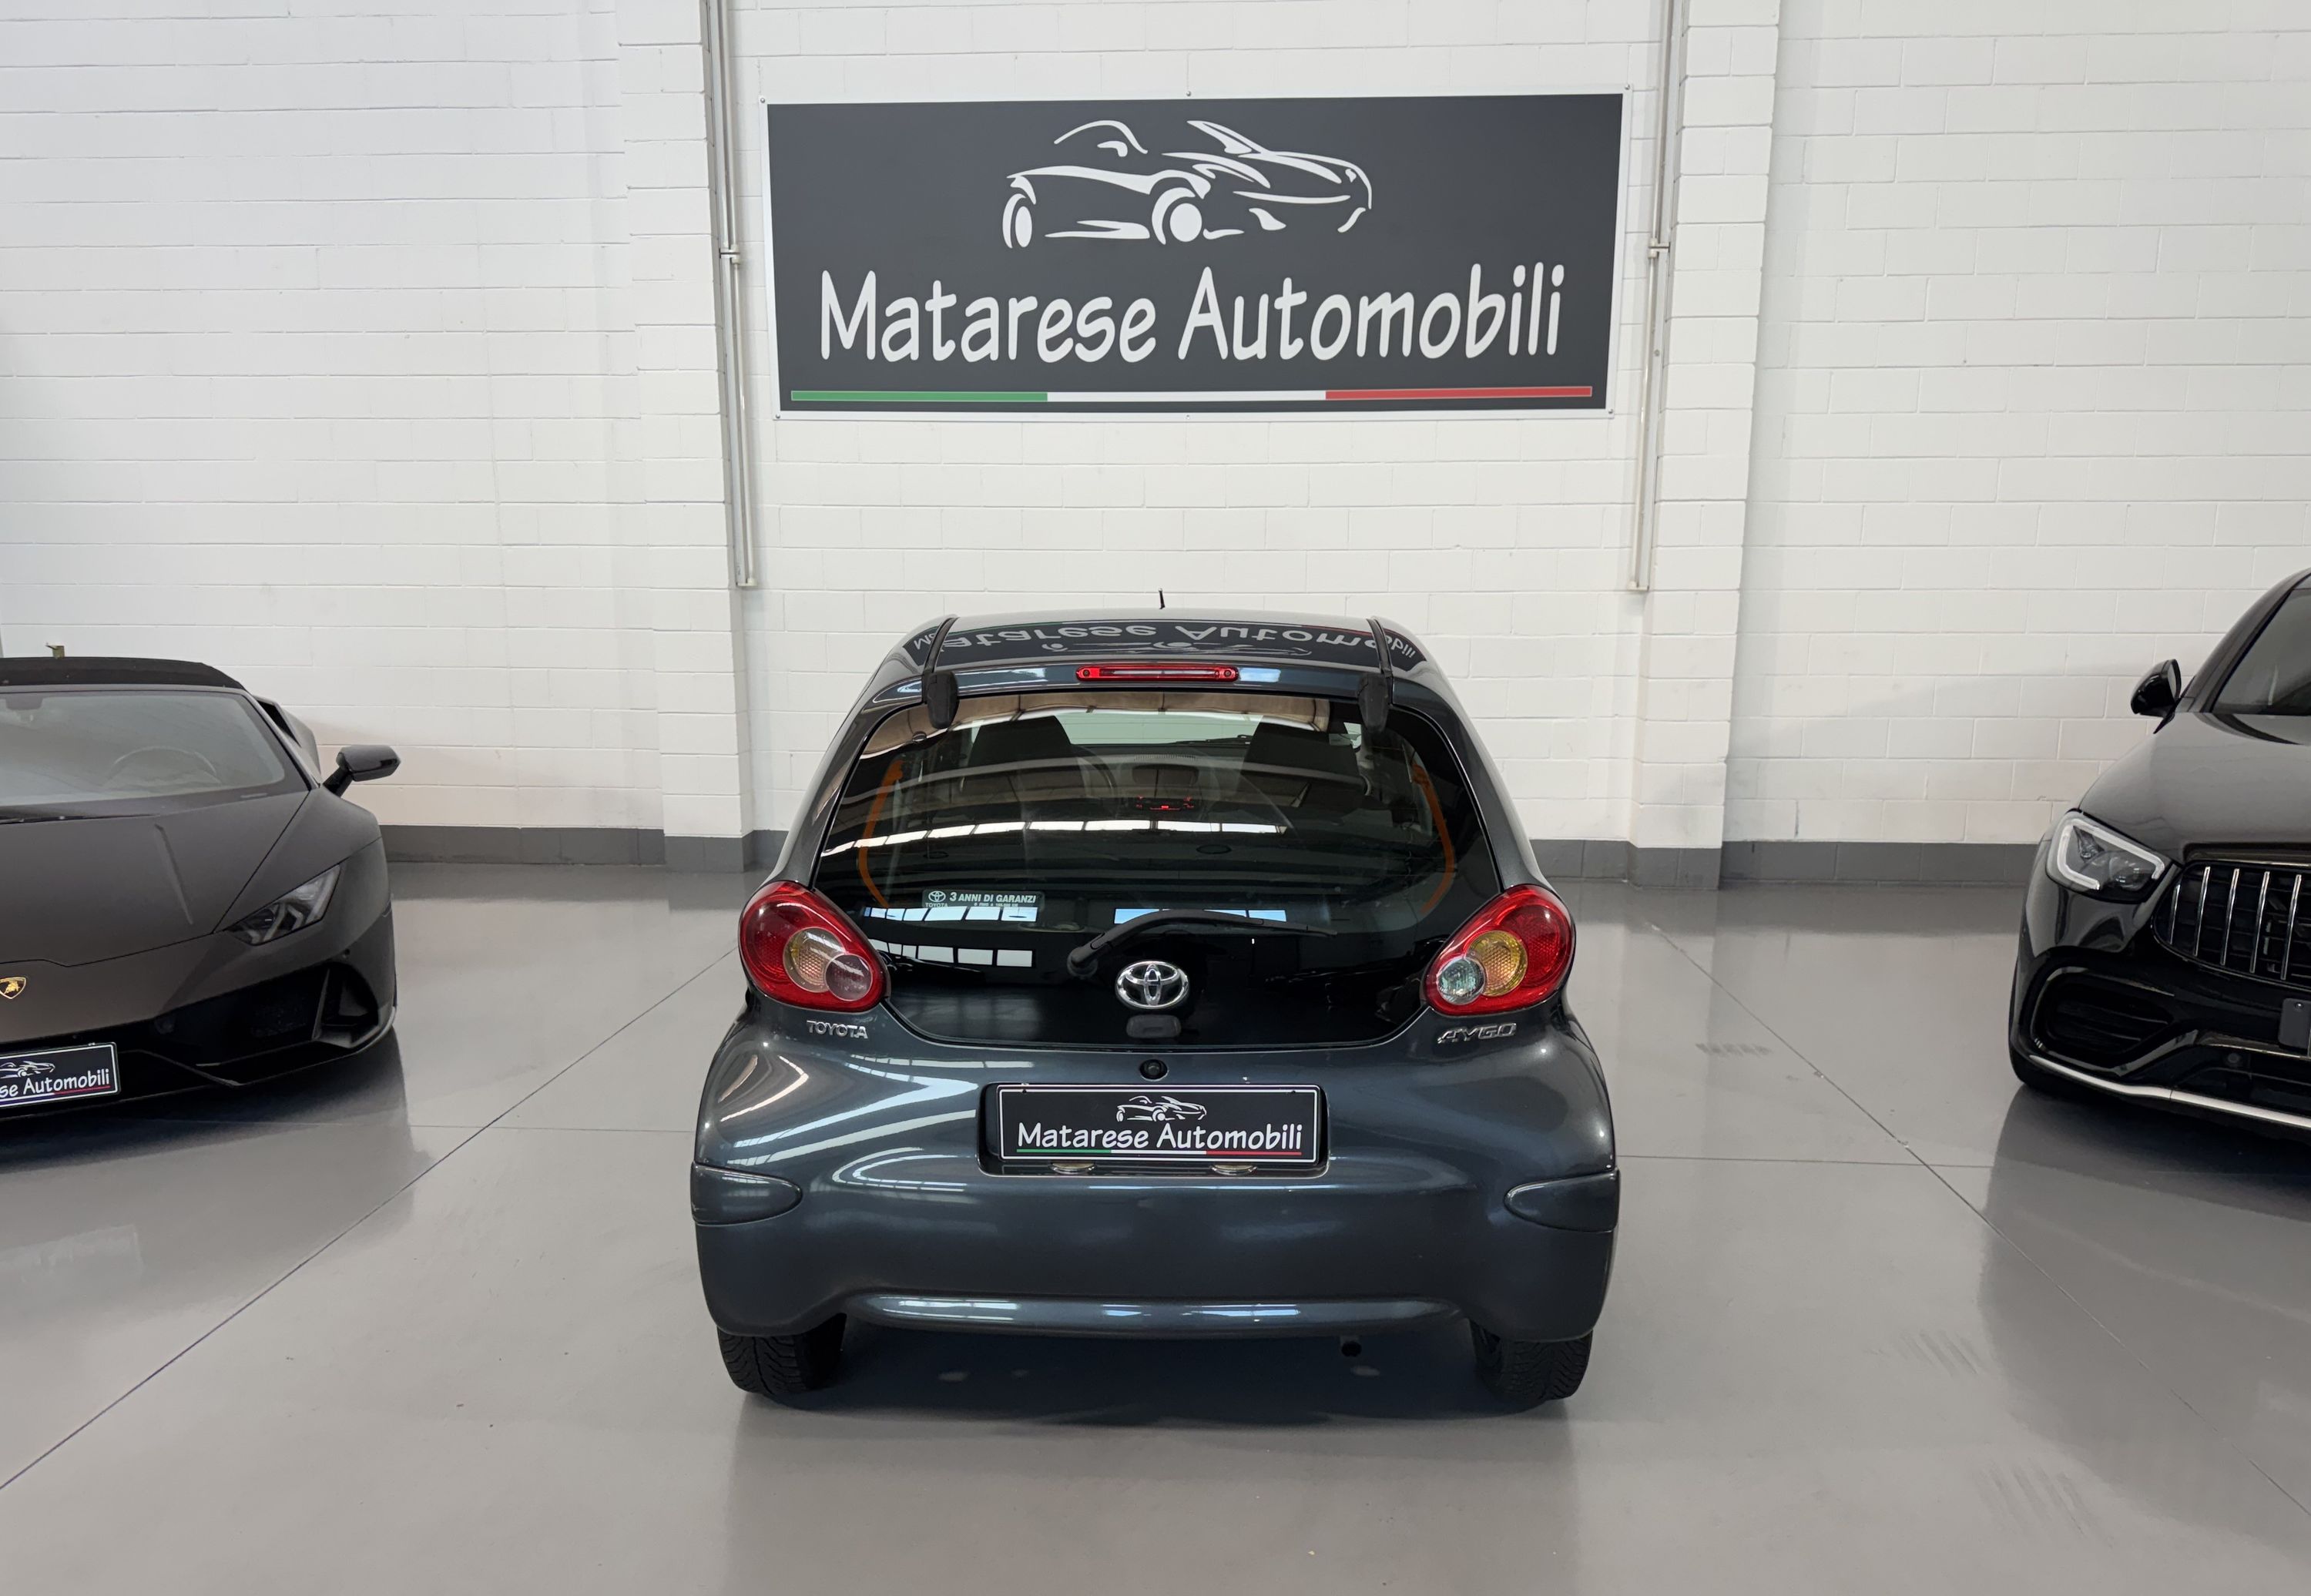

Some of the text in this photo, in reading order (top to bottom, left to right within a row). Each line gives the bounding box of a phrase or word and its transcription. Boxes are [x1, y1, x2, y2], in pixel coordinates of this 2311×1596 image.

[820, 262, 1565, 364] Matarese Automobili
[949, 891, 957, 902] 3
[958, 894, 982, 902] ANNI
[983, 894, 994, 903] DI
[807, 1020, 868, 1039] TOYOTA
[1437, 1023, 1517, 1044] AYGO
[23, 1068, 110, 1095] Automobili
[1018, 1122, 1303, 1150] Matarese Automobili
